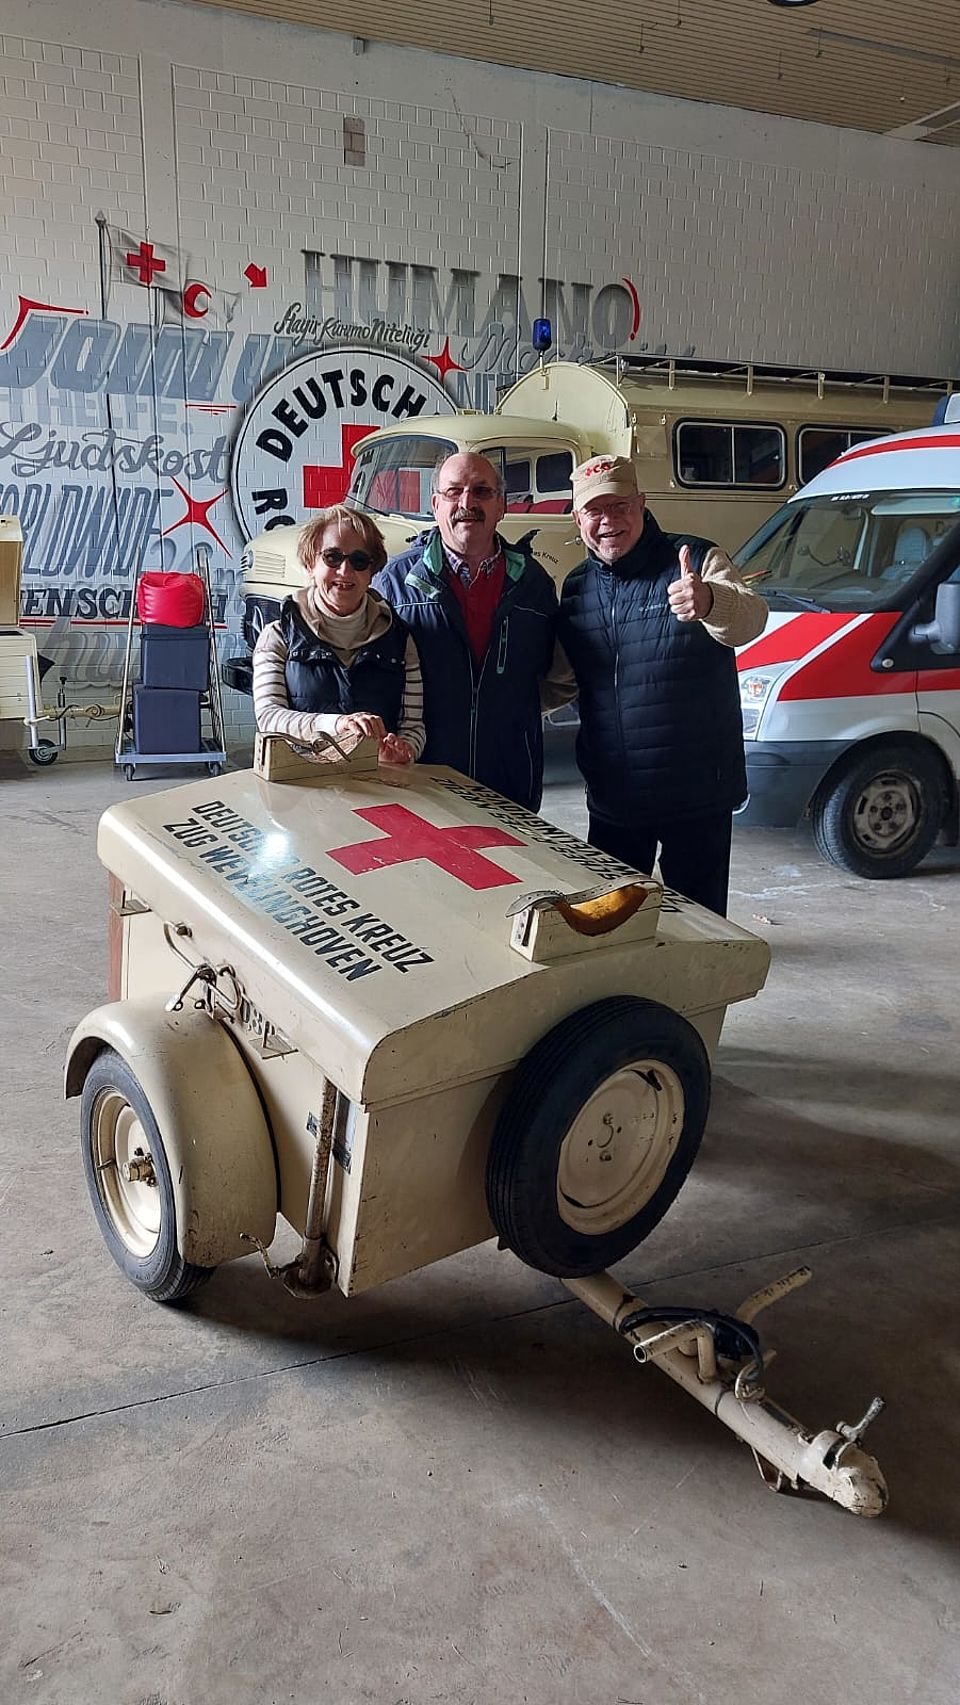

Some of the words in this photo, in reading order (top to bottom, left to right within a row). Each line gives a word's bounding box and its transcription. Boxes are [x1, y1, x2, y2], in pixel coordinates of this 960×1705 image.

[301, 249, 634, 349] HUMANO
[0, 314, 234, 401] JOIN
[255, 368, 428, 463] DEUTSCH
[542, 551, 559, 564] Kreuz
[162, 817, 219, 848] ZUG
[199, 845, 383, 982] WEVELINGHOVEN
[282, 867, 360, 917] ROTES
[341, 913, 435, 974] KREUZ
